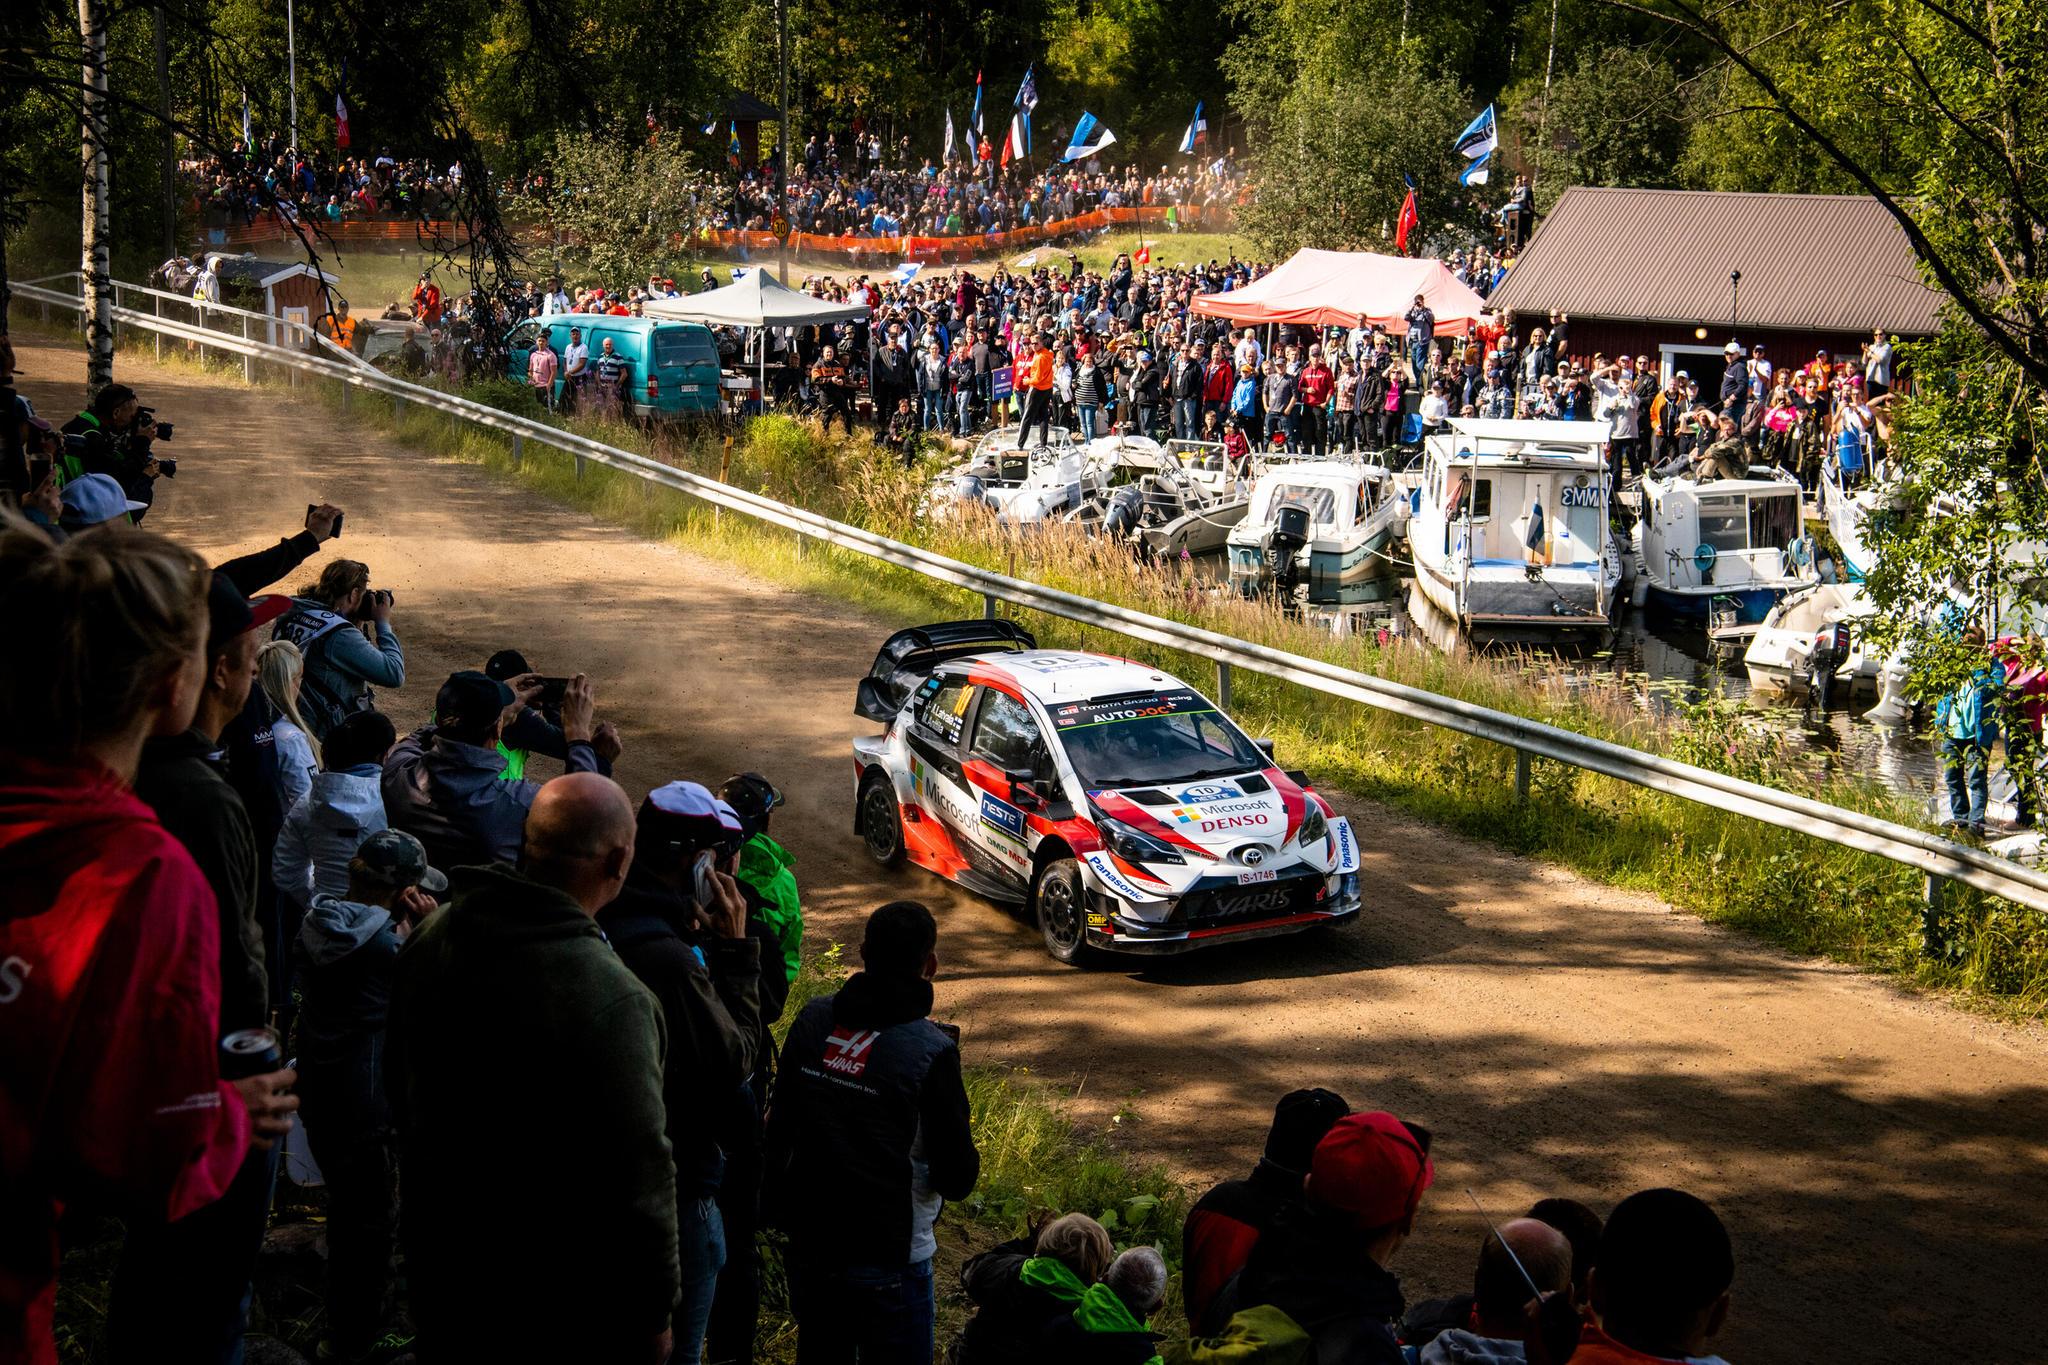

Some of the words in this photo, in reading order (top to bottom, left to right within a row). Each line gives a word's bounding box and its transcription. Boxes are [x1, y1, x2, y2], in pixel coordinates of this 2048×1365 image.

[775, 222, 786, 234] 30
[954, 684, 975, 716] 10
[1080, 700, 1121, 712] TOYOTA
[1122, 697, 1159, 706] GAZOO
[1195, 787, 1214, 795] 10
[926, 777, 982, 837] Microsoft
[1200, 800, 1272, 815] Microsoft
[1201, 814, 1269, 833] DENSO
[986, 836, 1008, 855] DMG
[1338, 822, 1353, 869] Panasonic
[1091, 856, 1144, 901] Panasonic
[1239, 869, 1276, 884] IS-1746
[1088, 915, 1107, 925] OMP
[823, 1056, 865, 1074] HAAS
